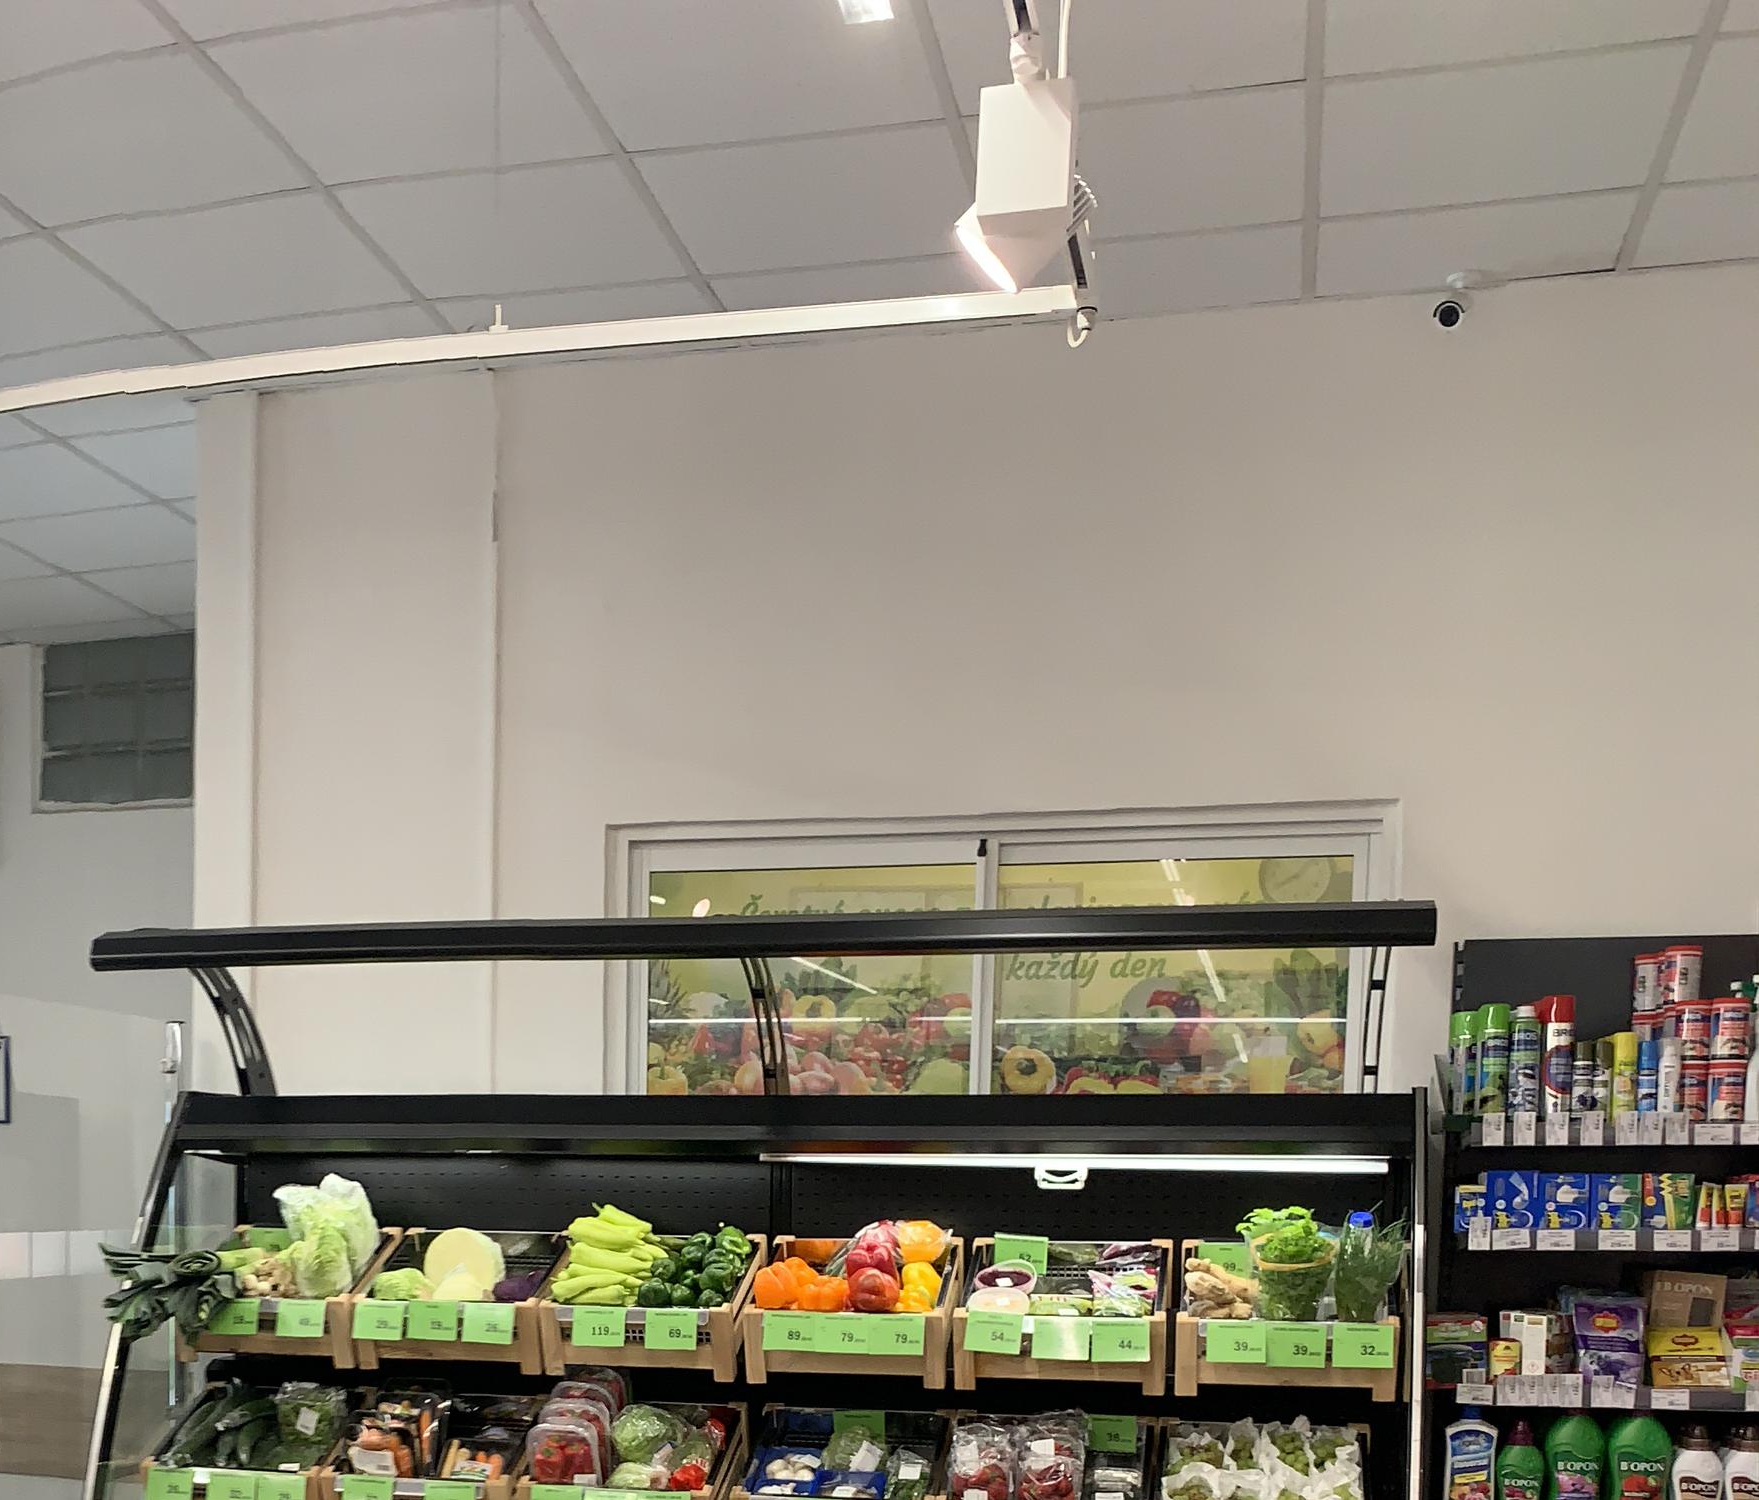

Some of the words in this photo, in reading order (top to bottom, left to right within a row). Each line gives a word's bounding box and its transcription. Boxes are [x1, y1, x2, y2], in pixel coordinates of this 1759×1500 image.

[1005, 949, 1099, 988] každý
[1110, 951, 1167, 979] den
[1557, 1461, 1599, 1472] BOPON
[1620, 1461, 1664, 1472] BOPON
